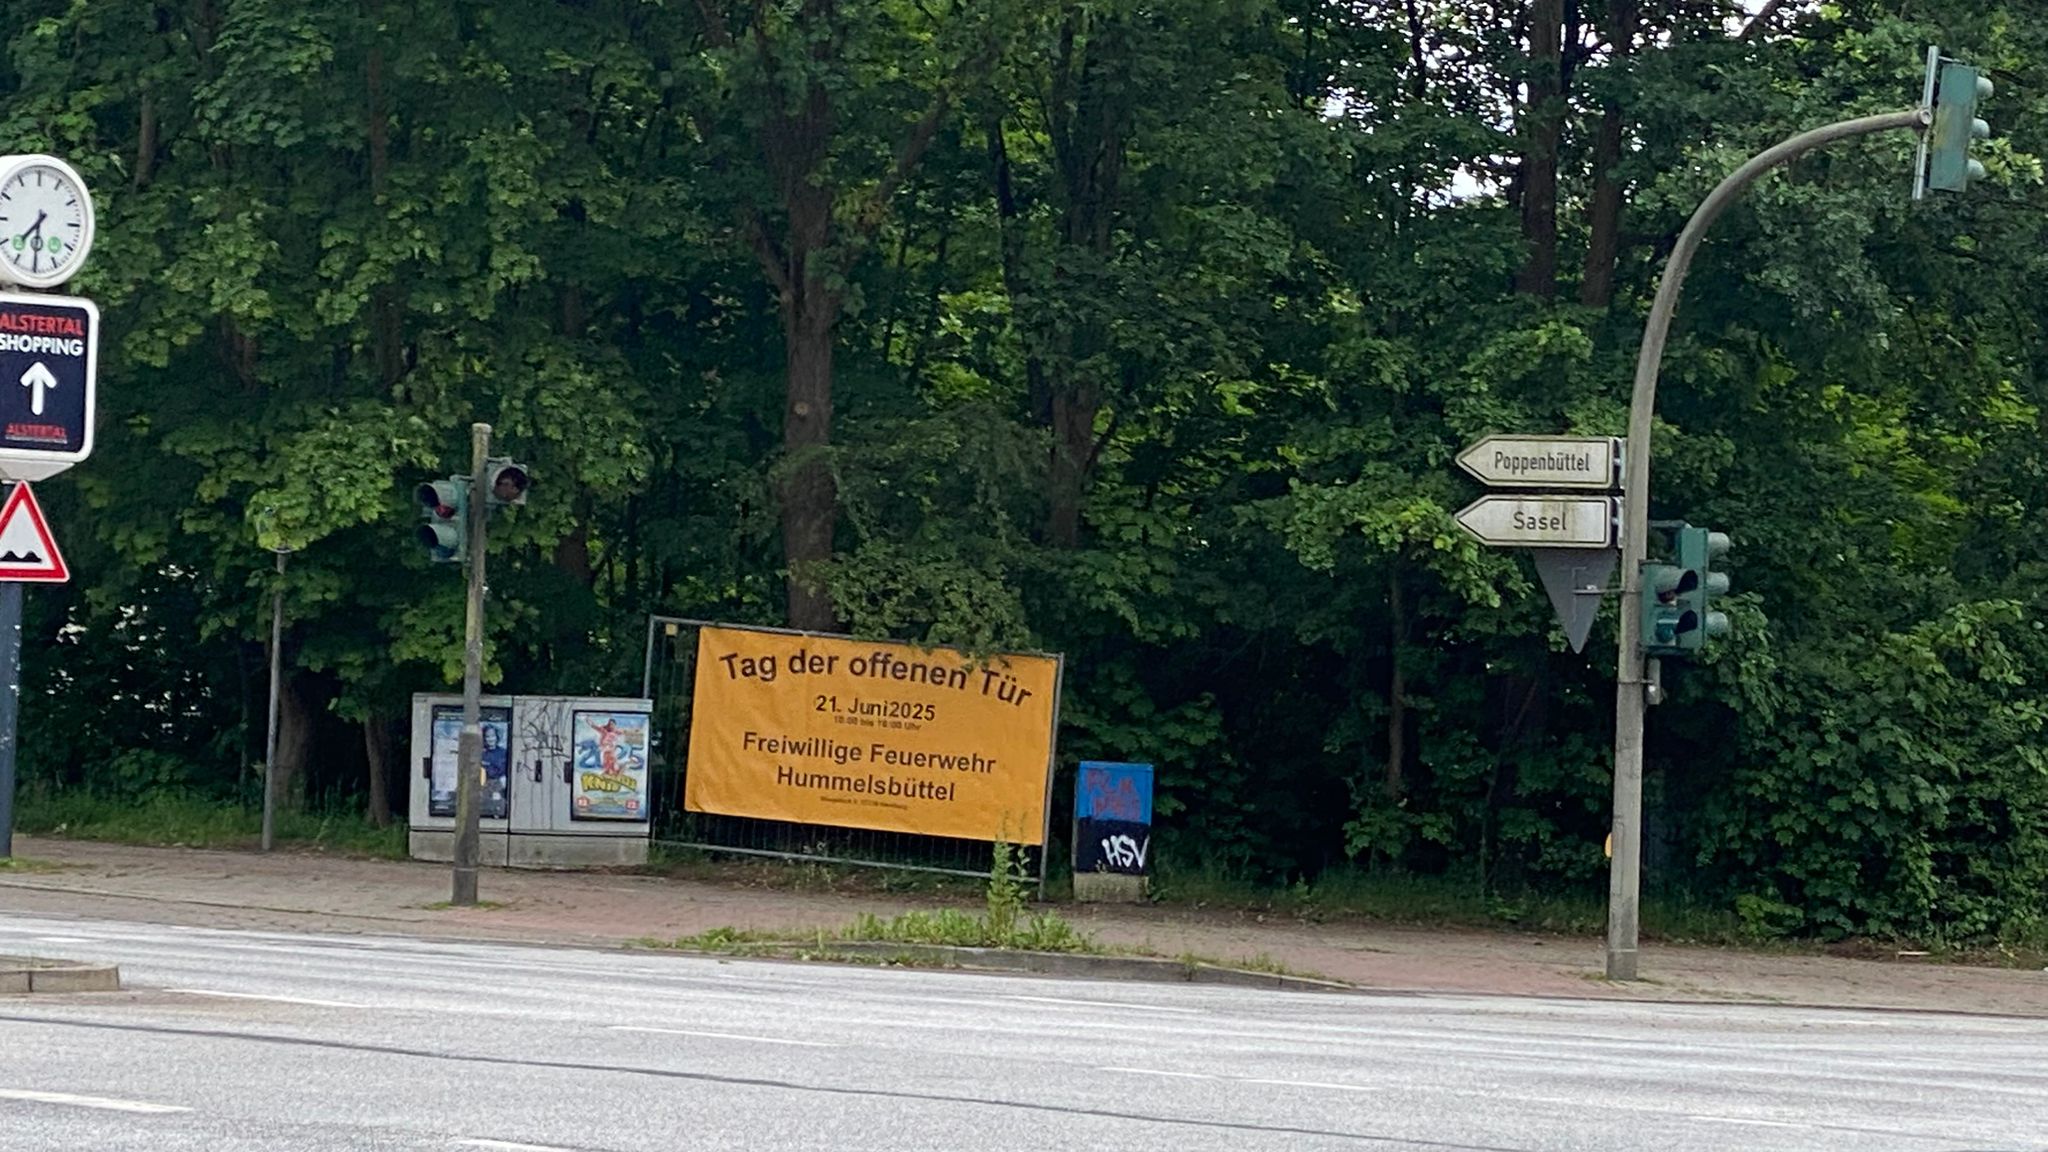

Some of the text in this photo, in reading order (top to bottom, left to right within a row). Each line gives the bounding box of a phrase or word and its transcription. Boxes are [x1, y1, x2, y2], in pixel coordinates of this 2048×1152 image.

[0, 313, 83, 335] ALSTERTAL
[0, 333, 84, 357] SHOPPING
[1495, 451, 1590, 475] Poppenbüttel
[1513, 511, 1567, 530] Sasel
[719, 648, 1032, 706] Tag der offenen Tür
[816, 695, 936, 721] 21. Juni2025
[743, 731, 996, 774] Freiwillige Feuerwehr
[777, 765, 955, 801] Hummelsbüttel
[1101, 834, 1150, 869] HSV
